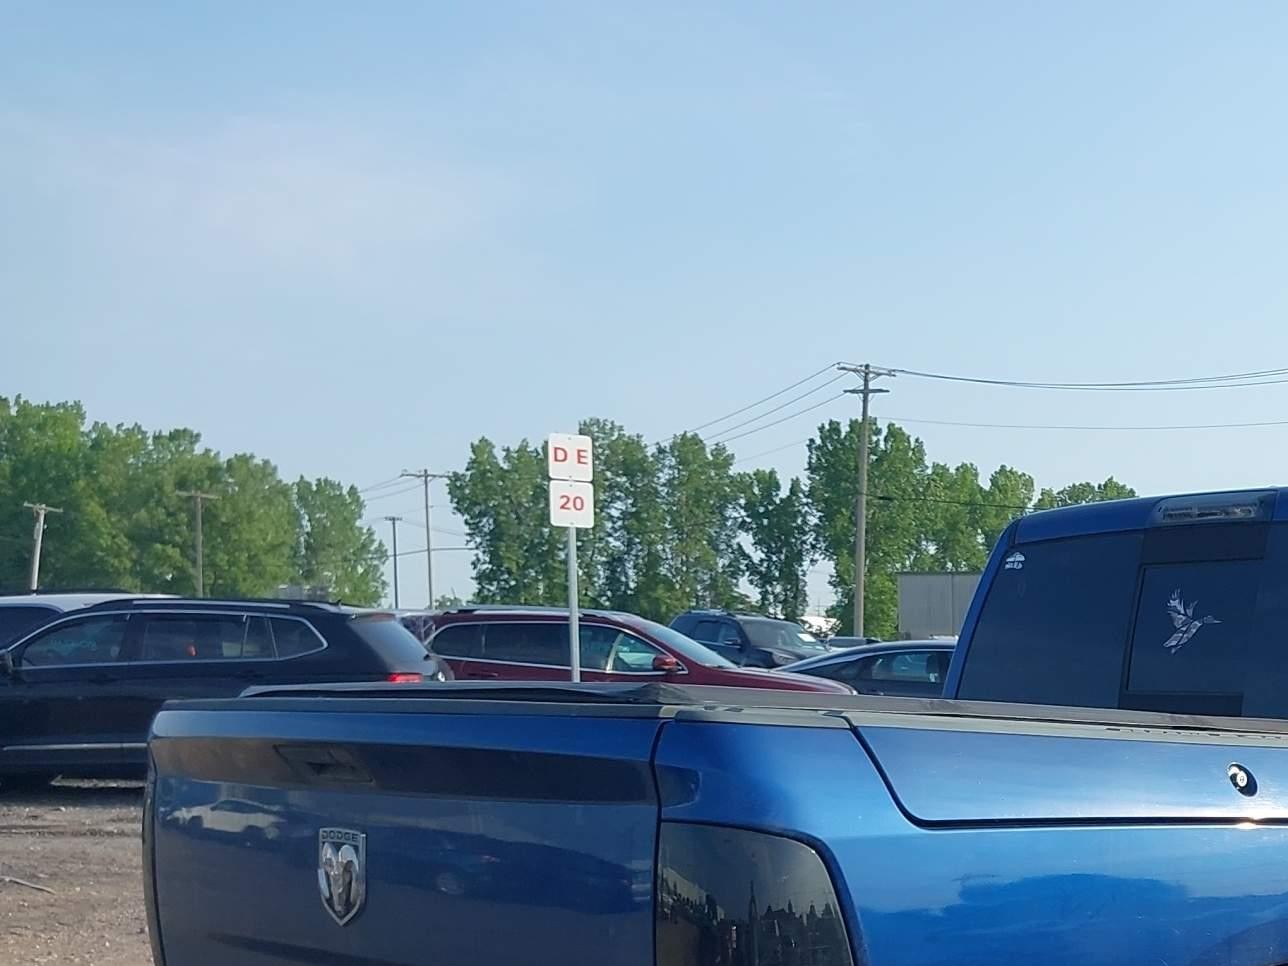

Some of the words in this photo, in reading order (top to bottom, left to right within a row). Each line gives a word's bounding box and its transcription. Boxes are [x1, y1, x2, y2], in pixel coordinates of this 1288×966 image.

[553, 446, 568, 463] D
[576, 448, 589, 465] E
[559, 494, 585, 511] 20
[321, 829, 359, 842] DODGE
